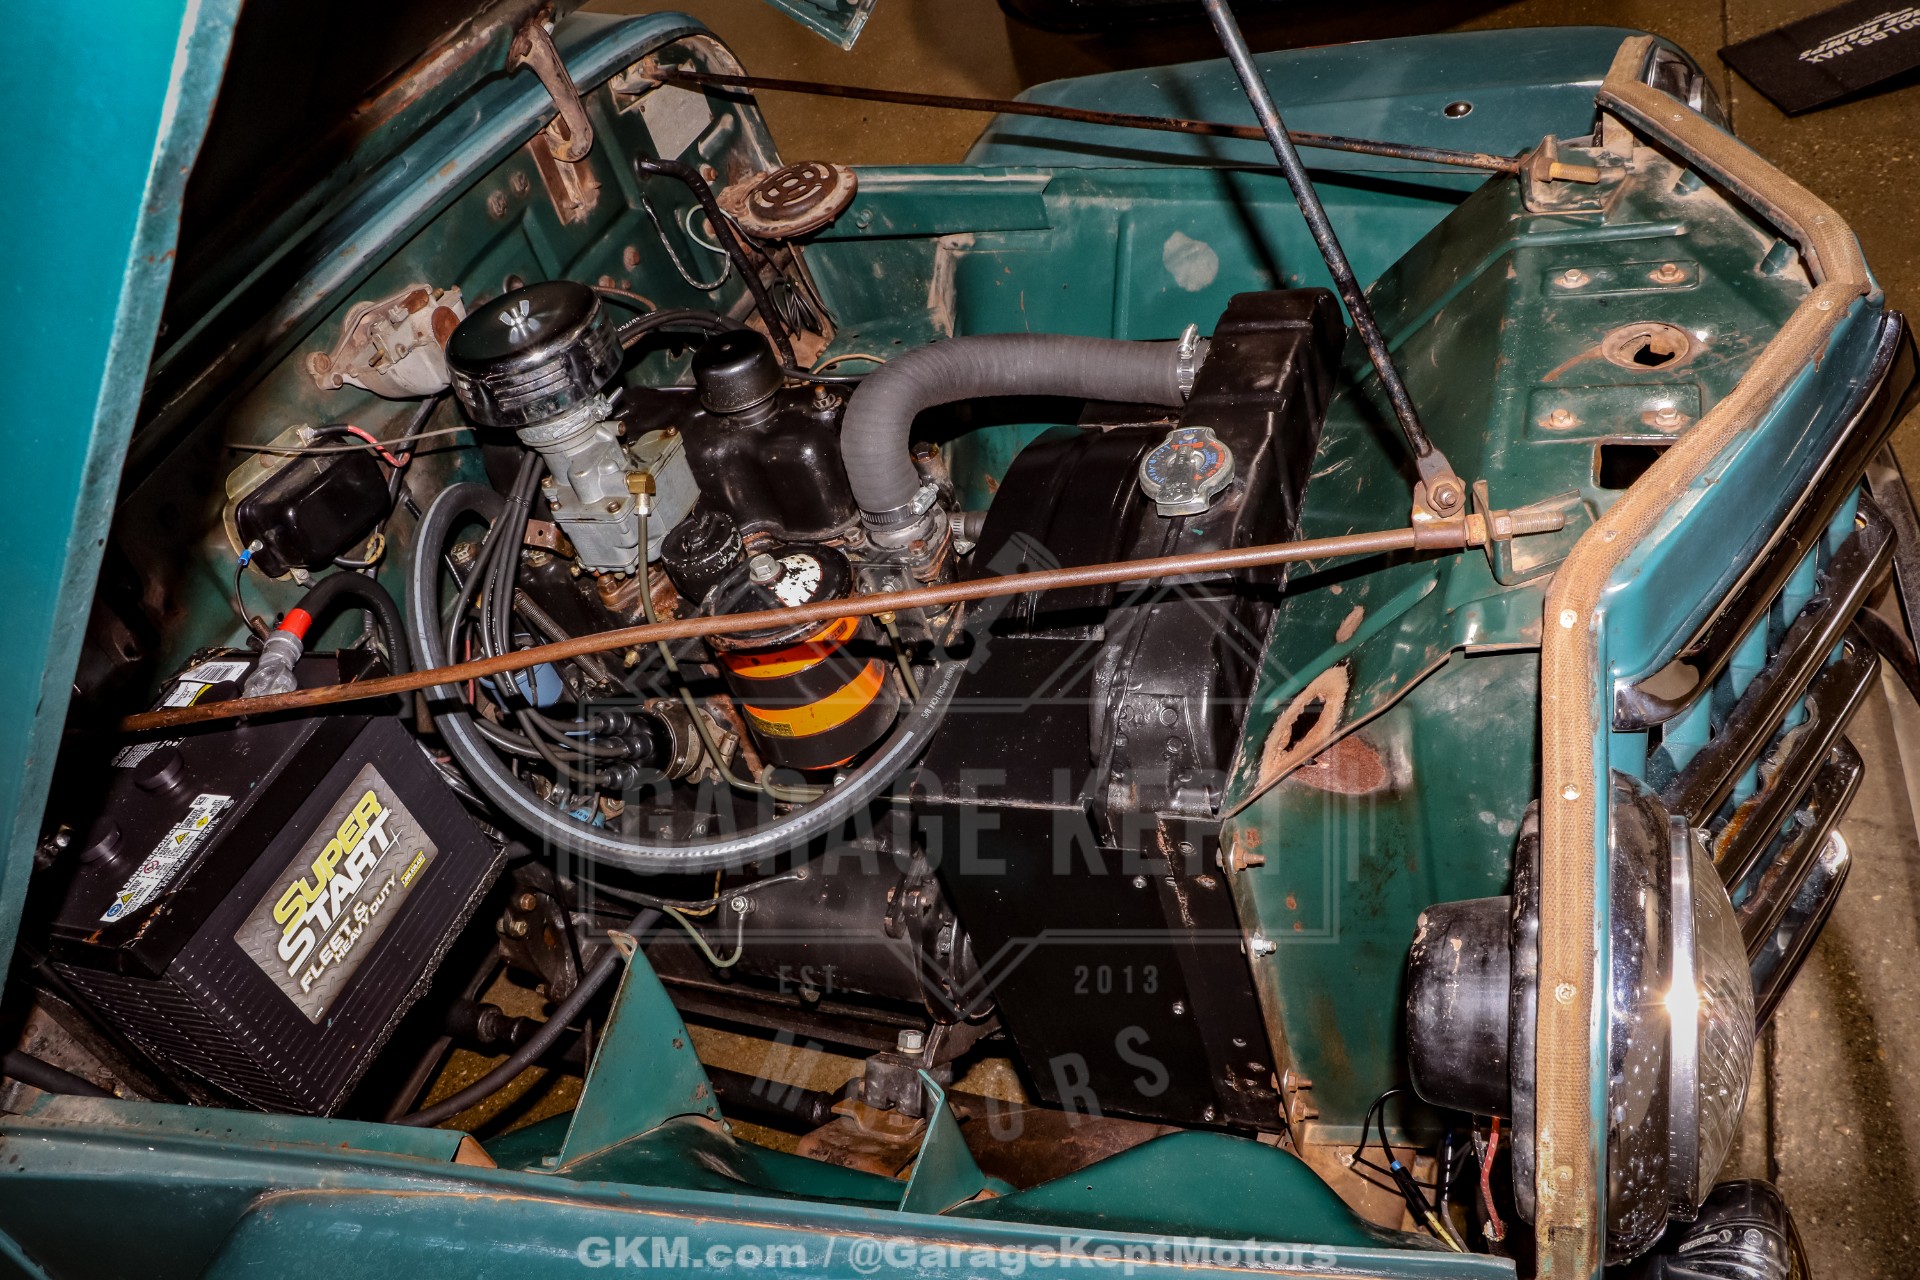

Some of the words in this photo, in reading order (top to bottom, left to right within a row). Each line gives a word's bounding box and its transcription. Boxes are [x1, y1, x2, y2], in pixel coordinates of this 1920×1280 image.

[1798, 24, 1880, 60] RAMPS
[1805, 44, 1853, 64] MAX
[1851, 27, 1900, 46] LBS.
[273, 790, 383, 935] SUPER
[278, 806, 391, 978] START
[300, 914, 352, 995] FLEET
[353, 900, 369, 920] &
[334, 913, 371, 965] HEAVY
[369, 874, 397, 917] DUTY
